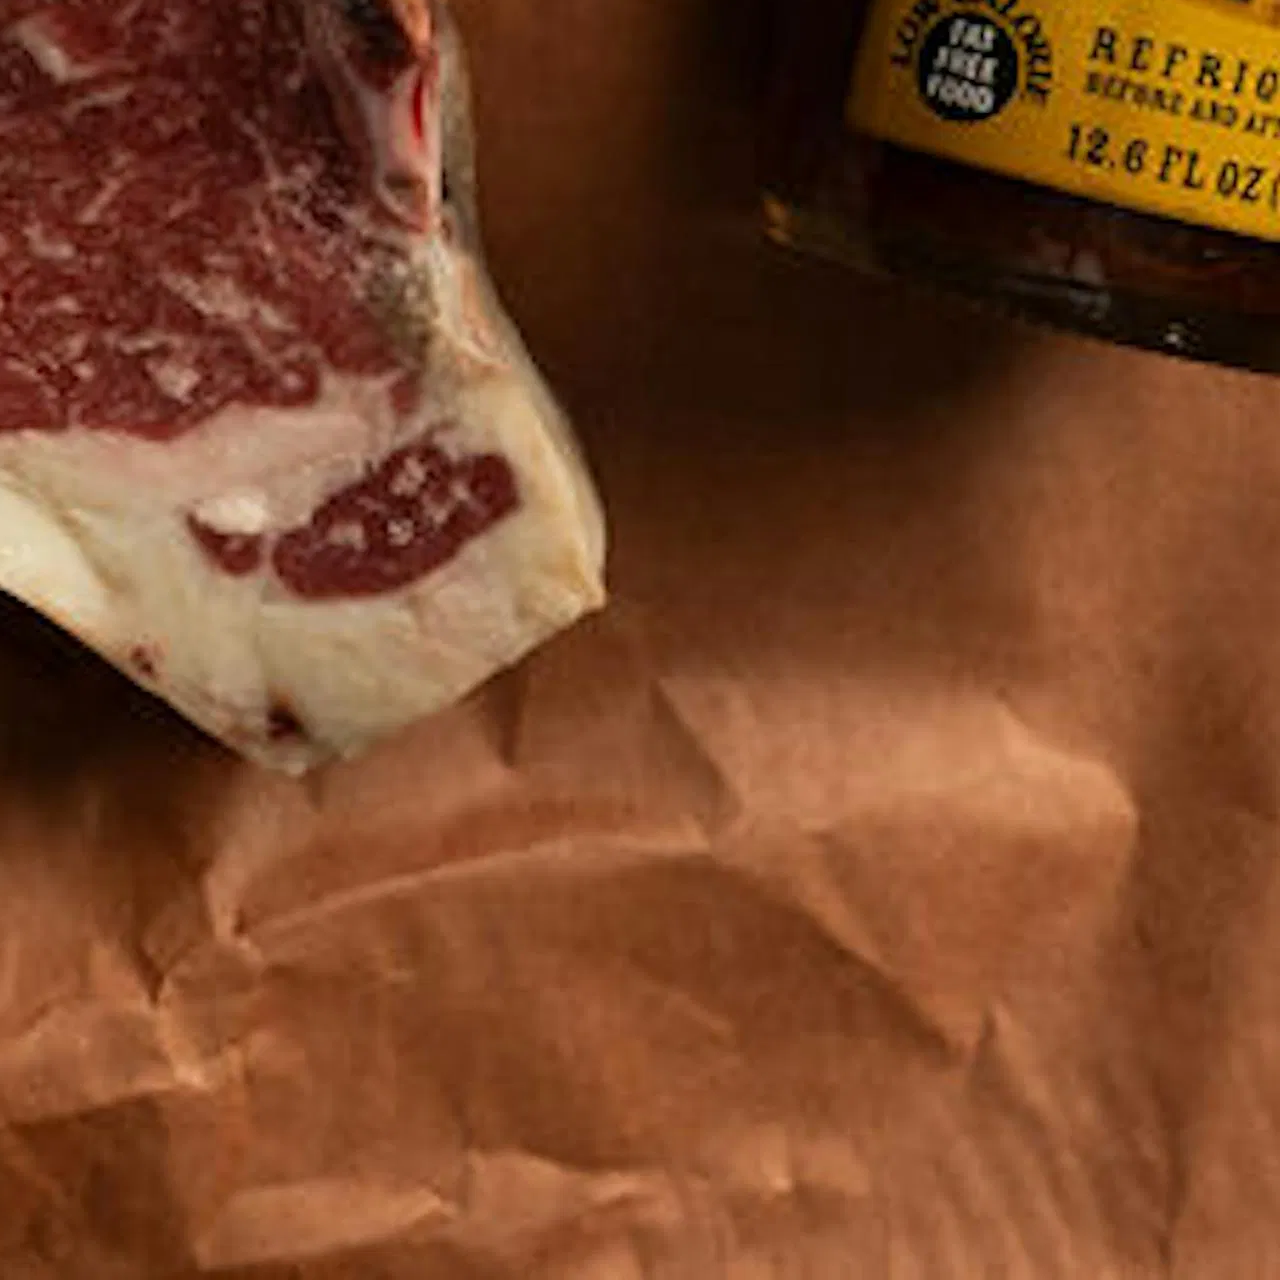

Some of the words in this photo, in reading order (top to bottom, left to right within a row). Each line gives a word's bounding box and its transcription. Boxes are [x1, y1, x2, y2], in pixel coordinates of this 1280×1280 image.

[1068, 123, 1150, 174] 12.6
[1158, 145, 1205, 190] FL
[1216, 160, 1266, 203] OZ
